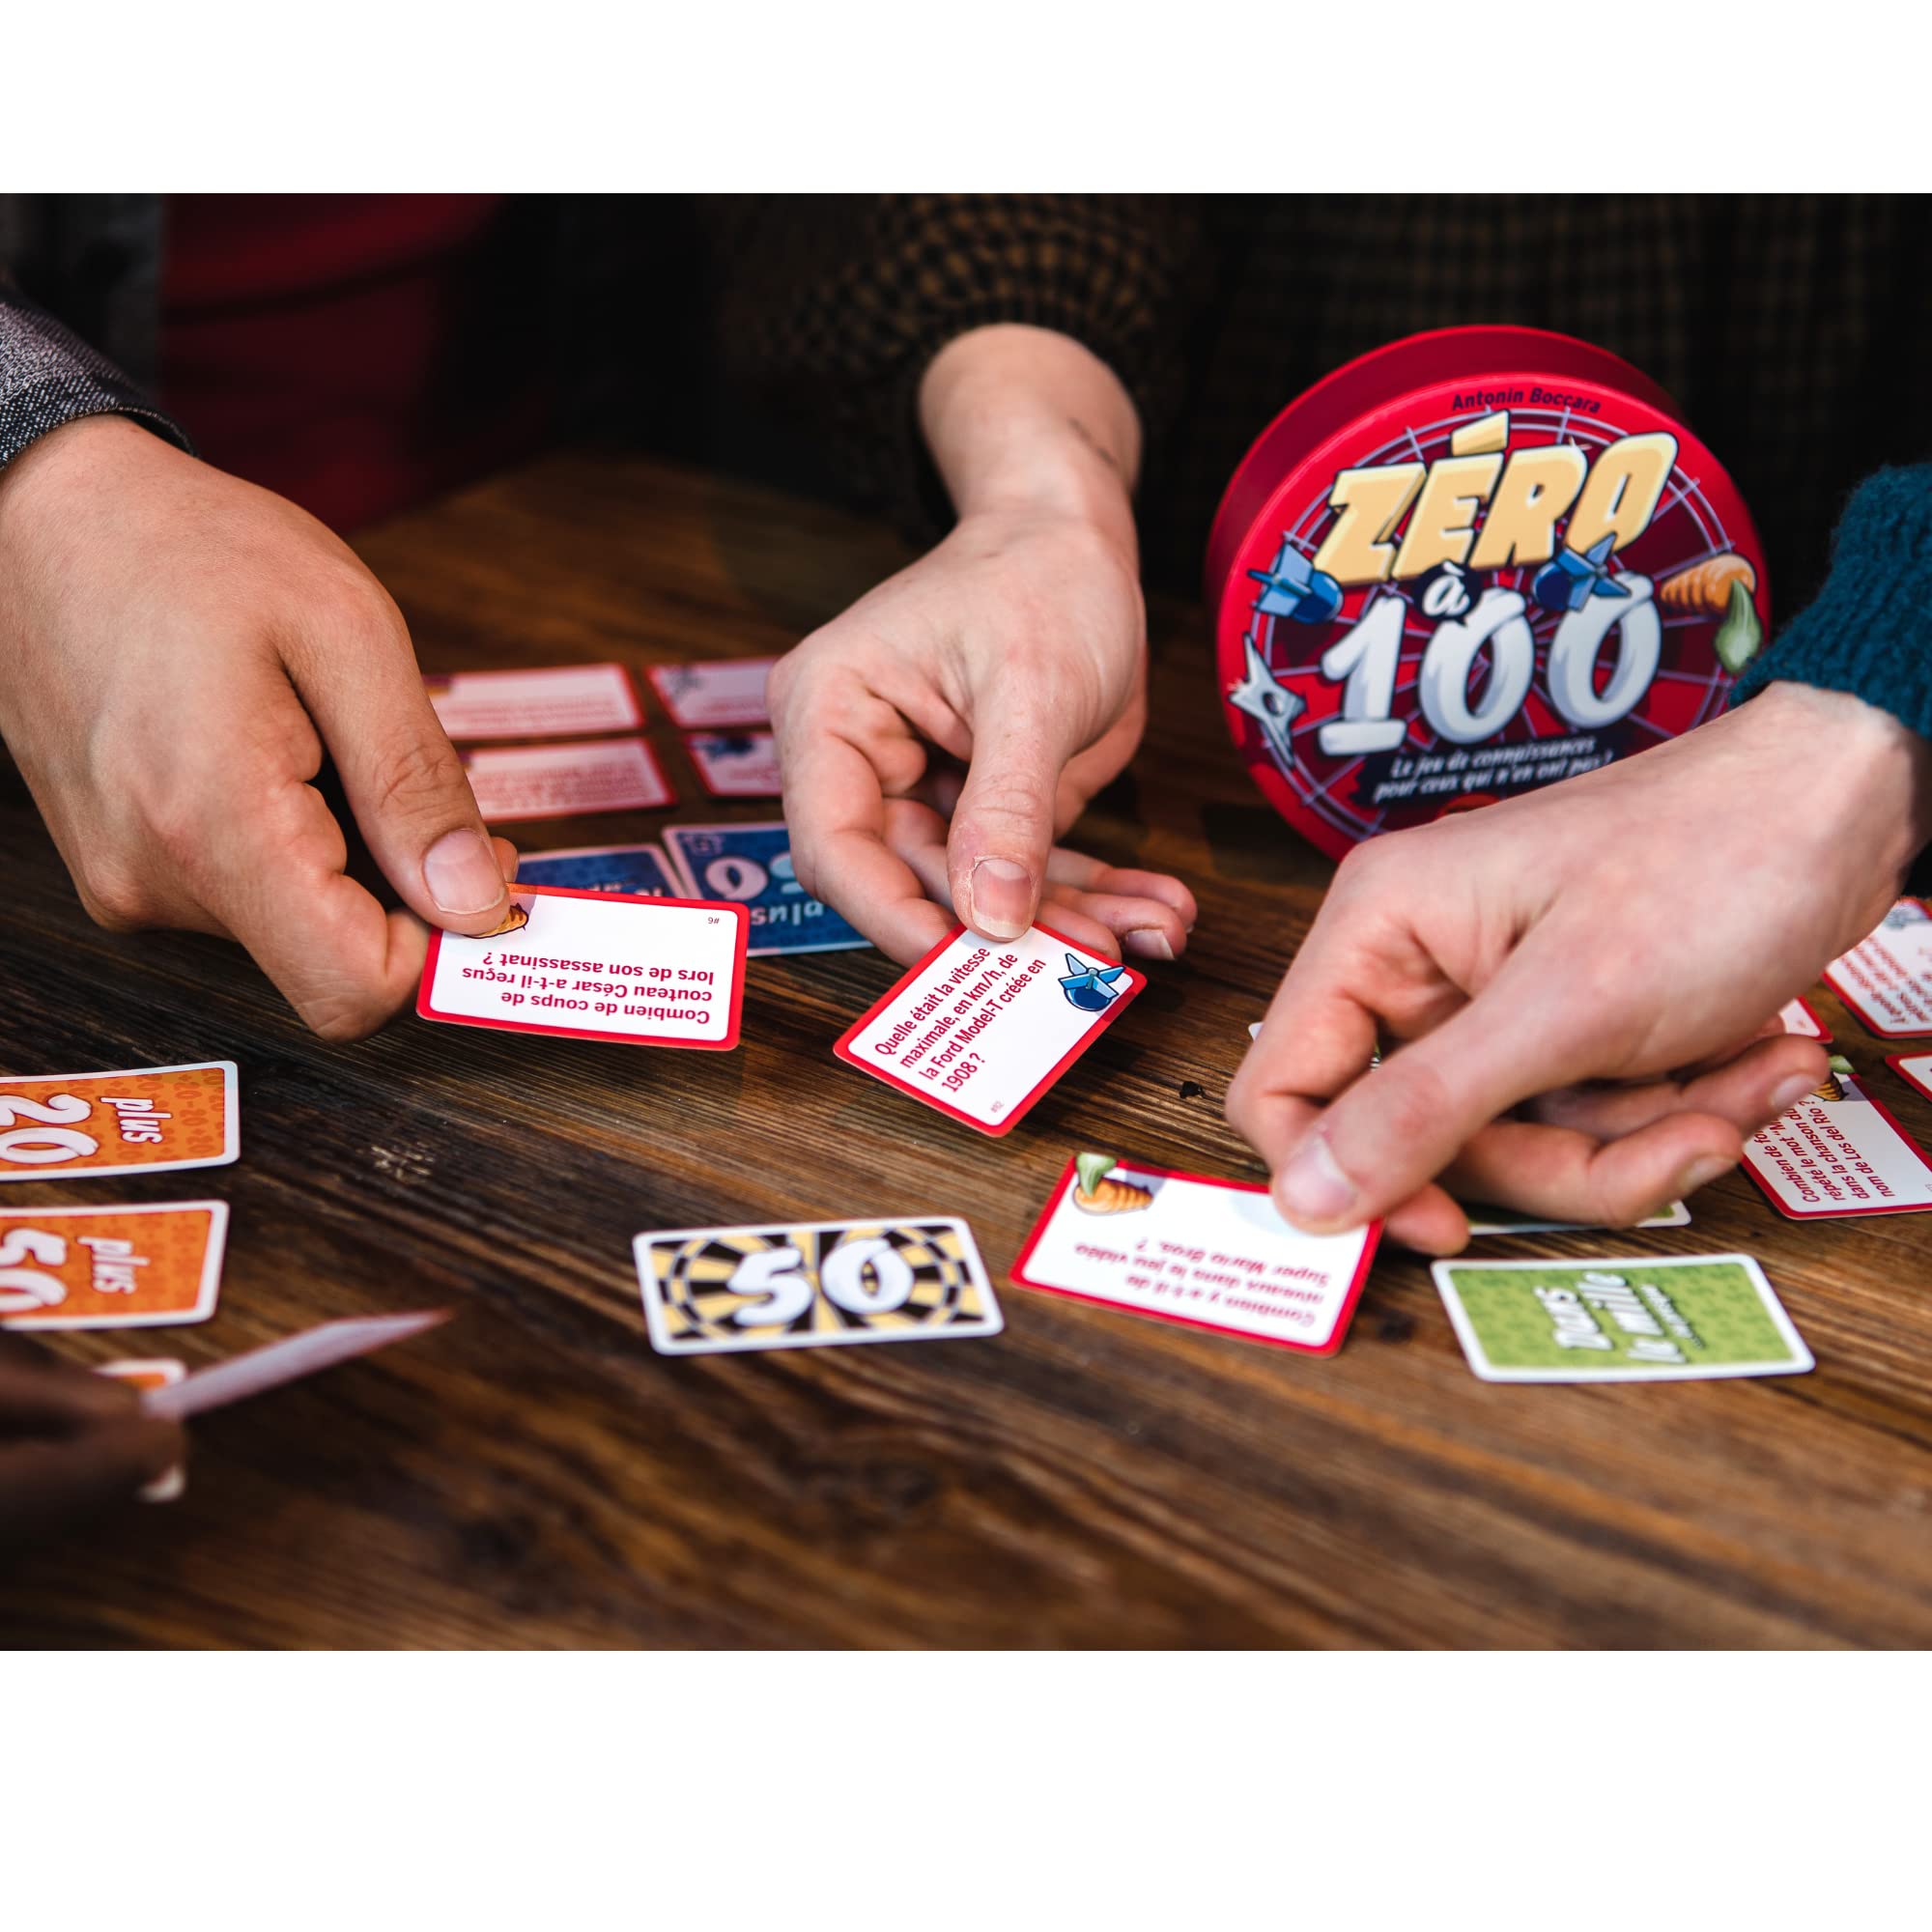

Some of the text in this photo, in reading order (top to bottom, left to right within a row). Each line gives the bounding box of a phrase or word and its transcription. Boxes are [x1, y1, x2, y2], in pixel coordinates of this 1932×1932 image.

[1452, 387, 1601, 413] Antonin Boccara
[1313, 410, 1678, 587] ZÉRO
[1422, 561, 1466, 615] à
[1319, 571, 1662, 756] 100
[1412, 754, 1443, 782] jeu
[1449, 751, 1470, 771] de
[1472, 737, 1597, 768] connaissances
[1374, 777, 1414, 803] pour
[1420, 774, 1459, 792] ceux
[1463, 767, 1491, 793] qui
[707, 917, 721, 925] #6
[751, 900, 824, 925] plus
[462, 967, 712, 1002] couteau César a-t-il reçus
[483, 952, 714, 985] lors de son assassinat ?
[501, 992, 710, 1025] Combien de coups de
[874, 948, 990, 1056] Quelle était la vitesse
[899, 952, 1017, 1068] maximale, en km/h, de
[918, 958, 1046, 1080] la Ford Model-T créée en
[941, 1052, 985, 1093] 1908 ?
[0, 1094, 99, 1164] 20
[99, 1096, 173, 1145] plus
[1819, 1126, 1845, 1141] del
[1764, 1146, 1782, 1158] de
[1779, 1136, 1846, 1201] répété le mot
[1785, 1108, 1870, 1200] dans la chanson du
[1838, 1143, 1862, 1160] Los
[1855, 1161, 1874, 1174] de
[1776, 1160, 1821, 1203] Combien
[1867, 1176, 1896, 1197] nom
[76, 1236, 151, 1294] plus
[726, 1237, 915, 1326] 50
[1125, 1273, 1151, 1289] de
[1133, 1256, 1166, 1274] jeu
[1169, 1264, 1188, 1277] le
[1192, 1269, 1241, 1287] dans
[1210, 1253, 1266, 1275] Mario
[1273, 1266, 1329, 1288] Super
[1226, 1297, 1315, 1326] Combien
[1576, 1271, 1664, 1336] mille
